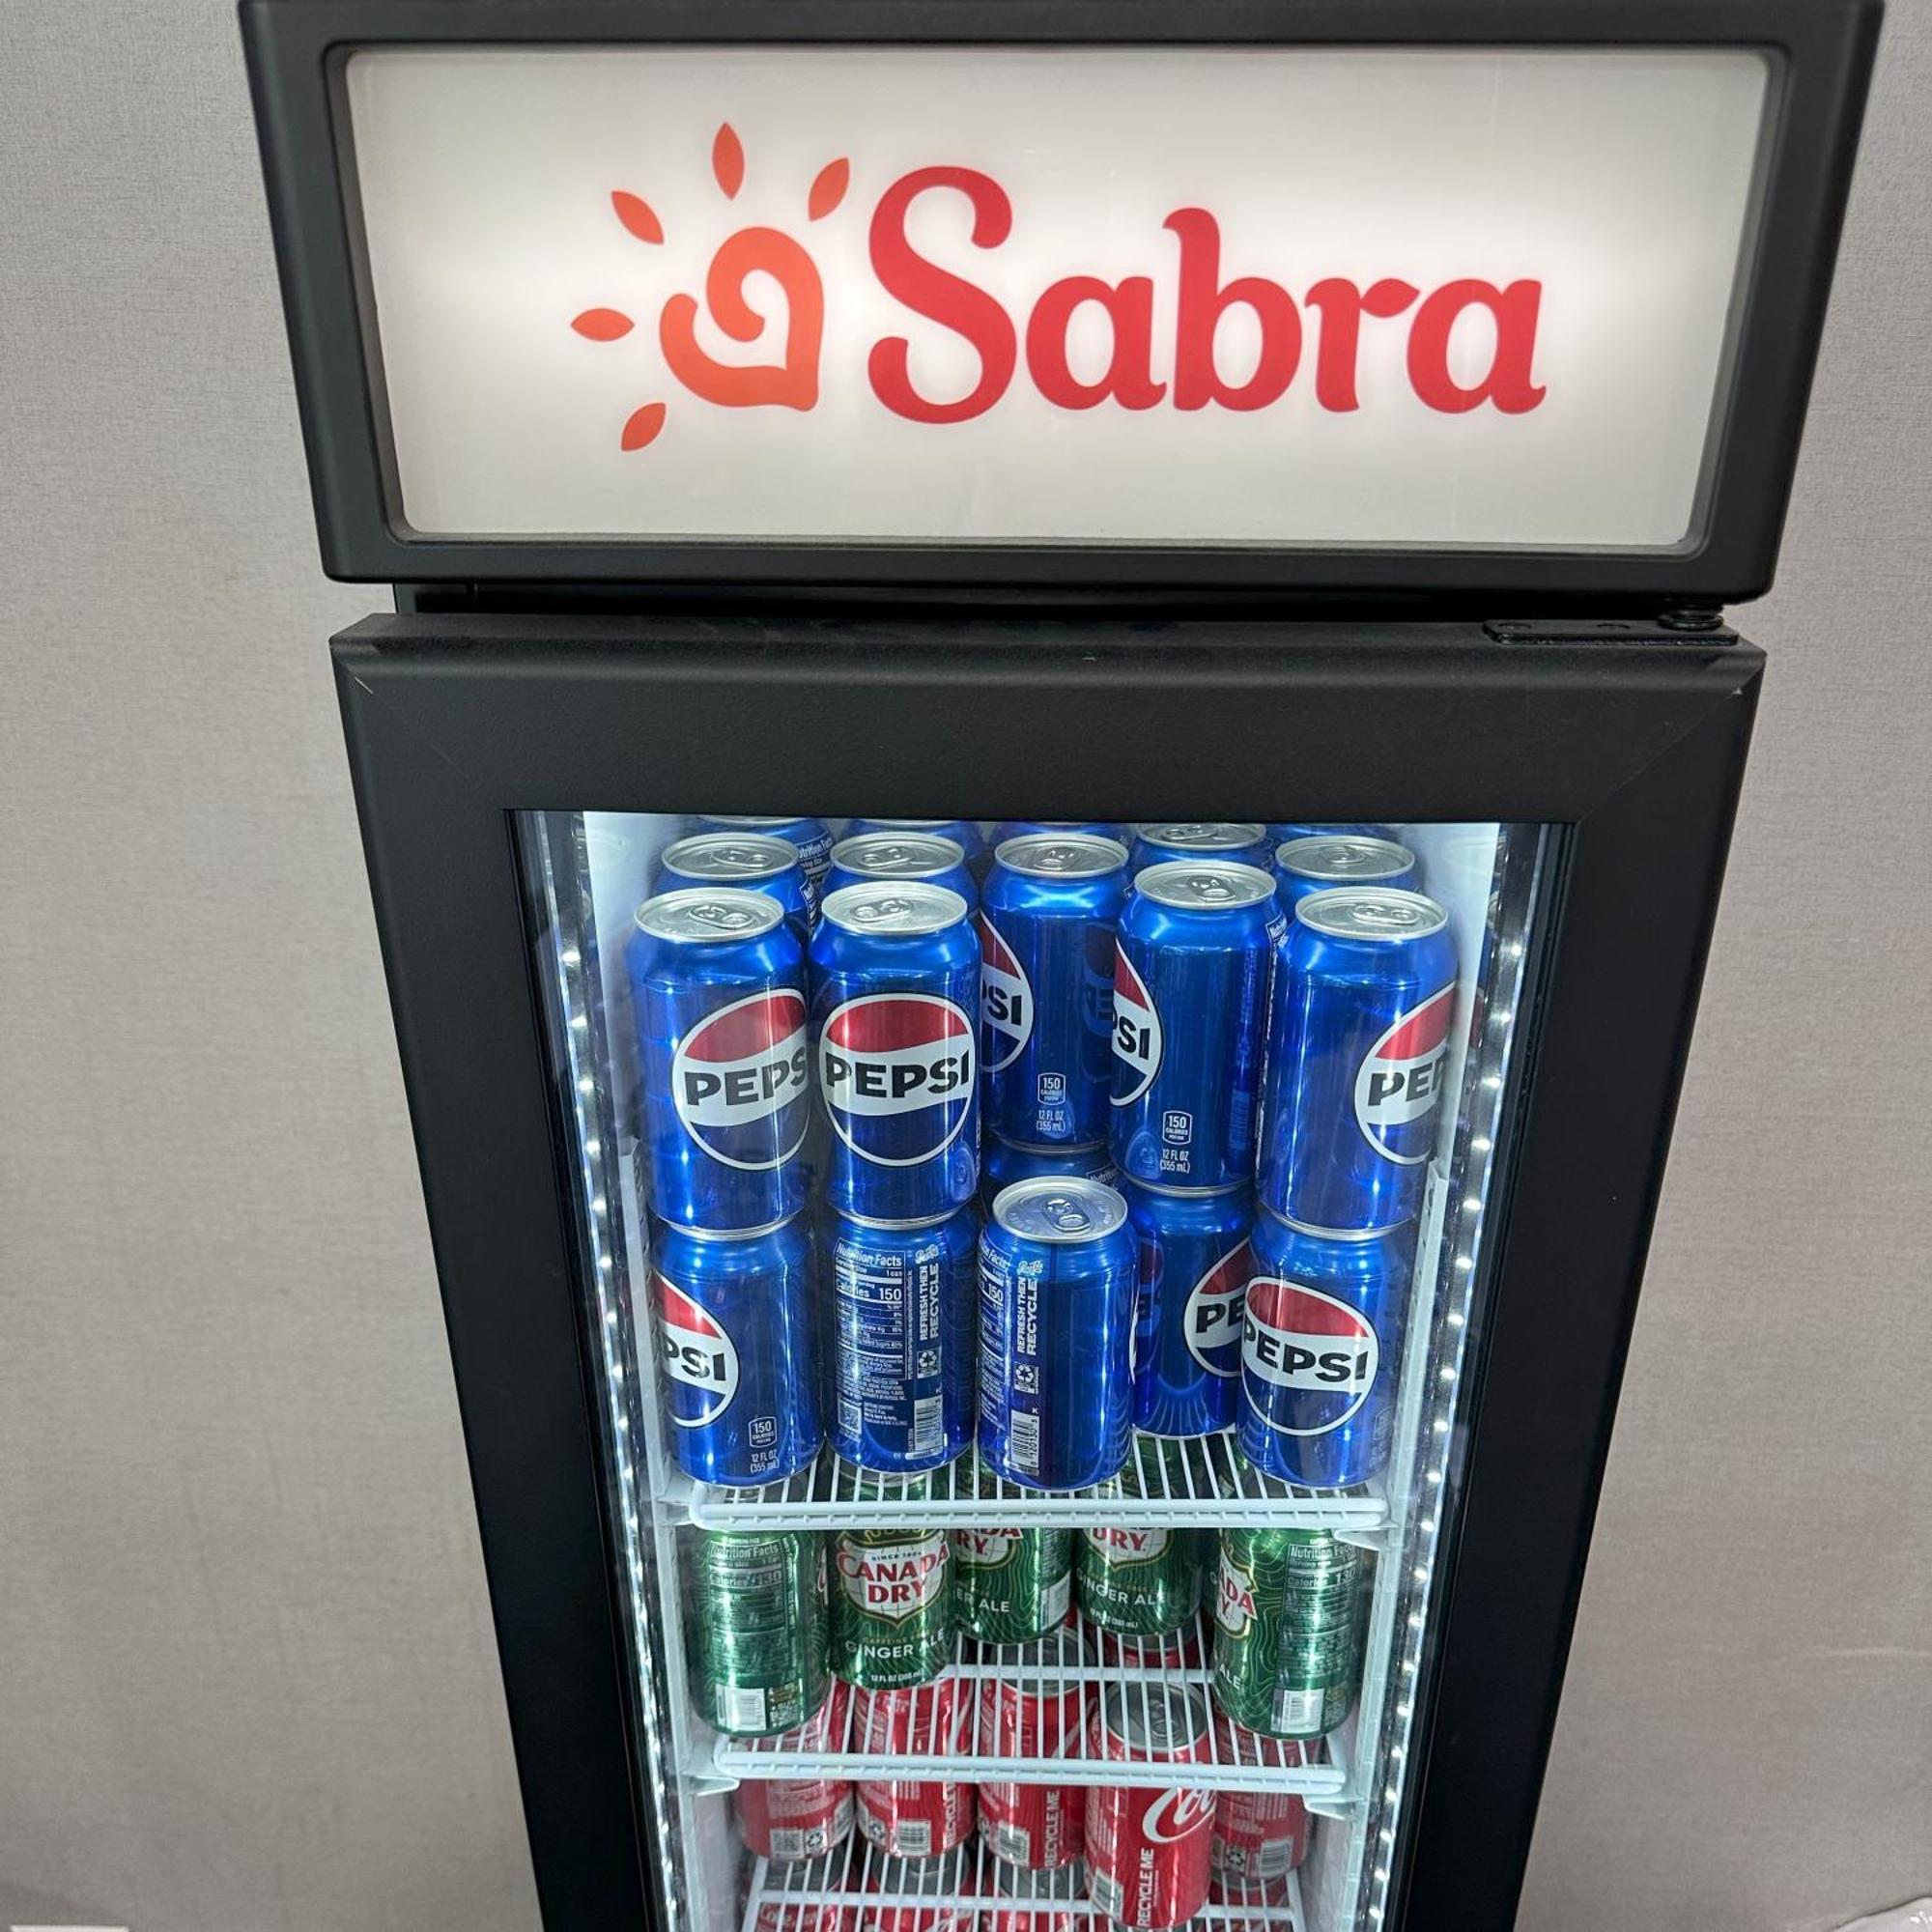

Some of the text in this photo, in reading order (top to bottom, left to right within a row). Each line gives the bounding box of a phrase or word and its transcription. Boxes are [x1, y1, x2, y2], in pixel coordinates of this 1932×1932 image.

[867, 165, 1546, 424] Sabra
[981, 980, 1022, 1027] SI
[1113, 1008, 1151, 1061] SI
[825, 1049, 970, 1098] PEPSI
[1042, 1077, 1062, 1090] 150
[1168, 1115, 1187, 1128] 150
[837, 1242, 873, 1262] Nutrition
[875, 1253, 902, 1267] Facts
[878, 1288, 902, 1301] 150
[919, 1265, 928, 1342] REFRESH THEN
[929, 1263, 939, 1340] RECYCLE
[1017, 1277, 1026, 1353] REFRESH THEN
[1027, 1277, 1037, 1356] RECYCLE
[1242, 1312, 1369, 1382] PEPSI
[753, 1420, 772, 1435] 150
[753, 1545, 779, 1557] Facts
[837, 1543, 949, 1581] CANADA
[757, 1571, 782, 1585] 130
[868, 1579, 927, 1604] DRY
[1076, 1567, 1166, 1605] GINGER ALE
[979, 1598, 1010, 1613] ALE
[845, 1640, 914, 1659] GINGER
[919, 1627, 944, 1650] ALE
[1219, 1663, 1243, 1690] ALE
[1044, 1790, 1060, 1868] RECYCLE ME
[1137, 1847, 1154, 1927] RECYCLE ME
